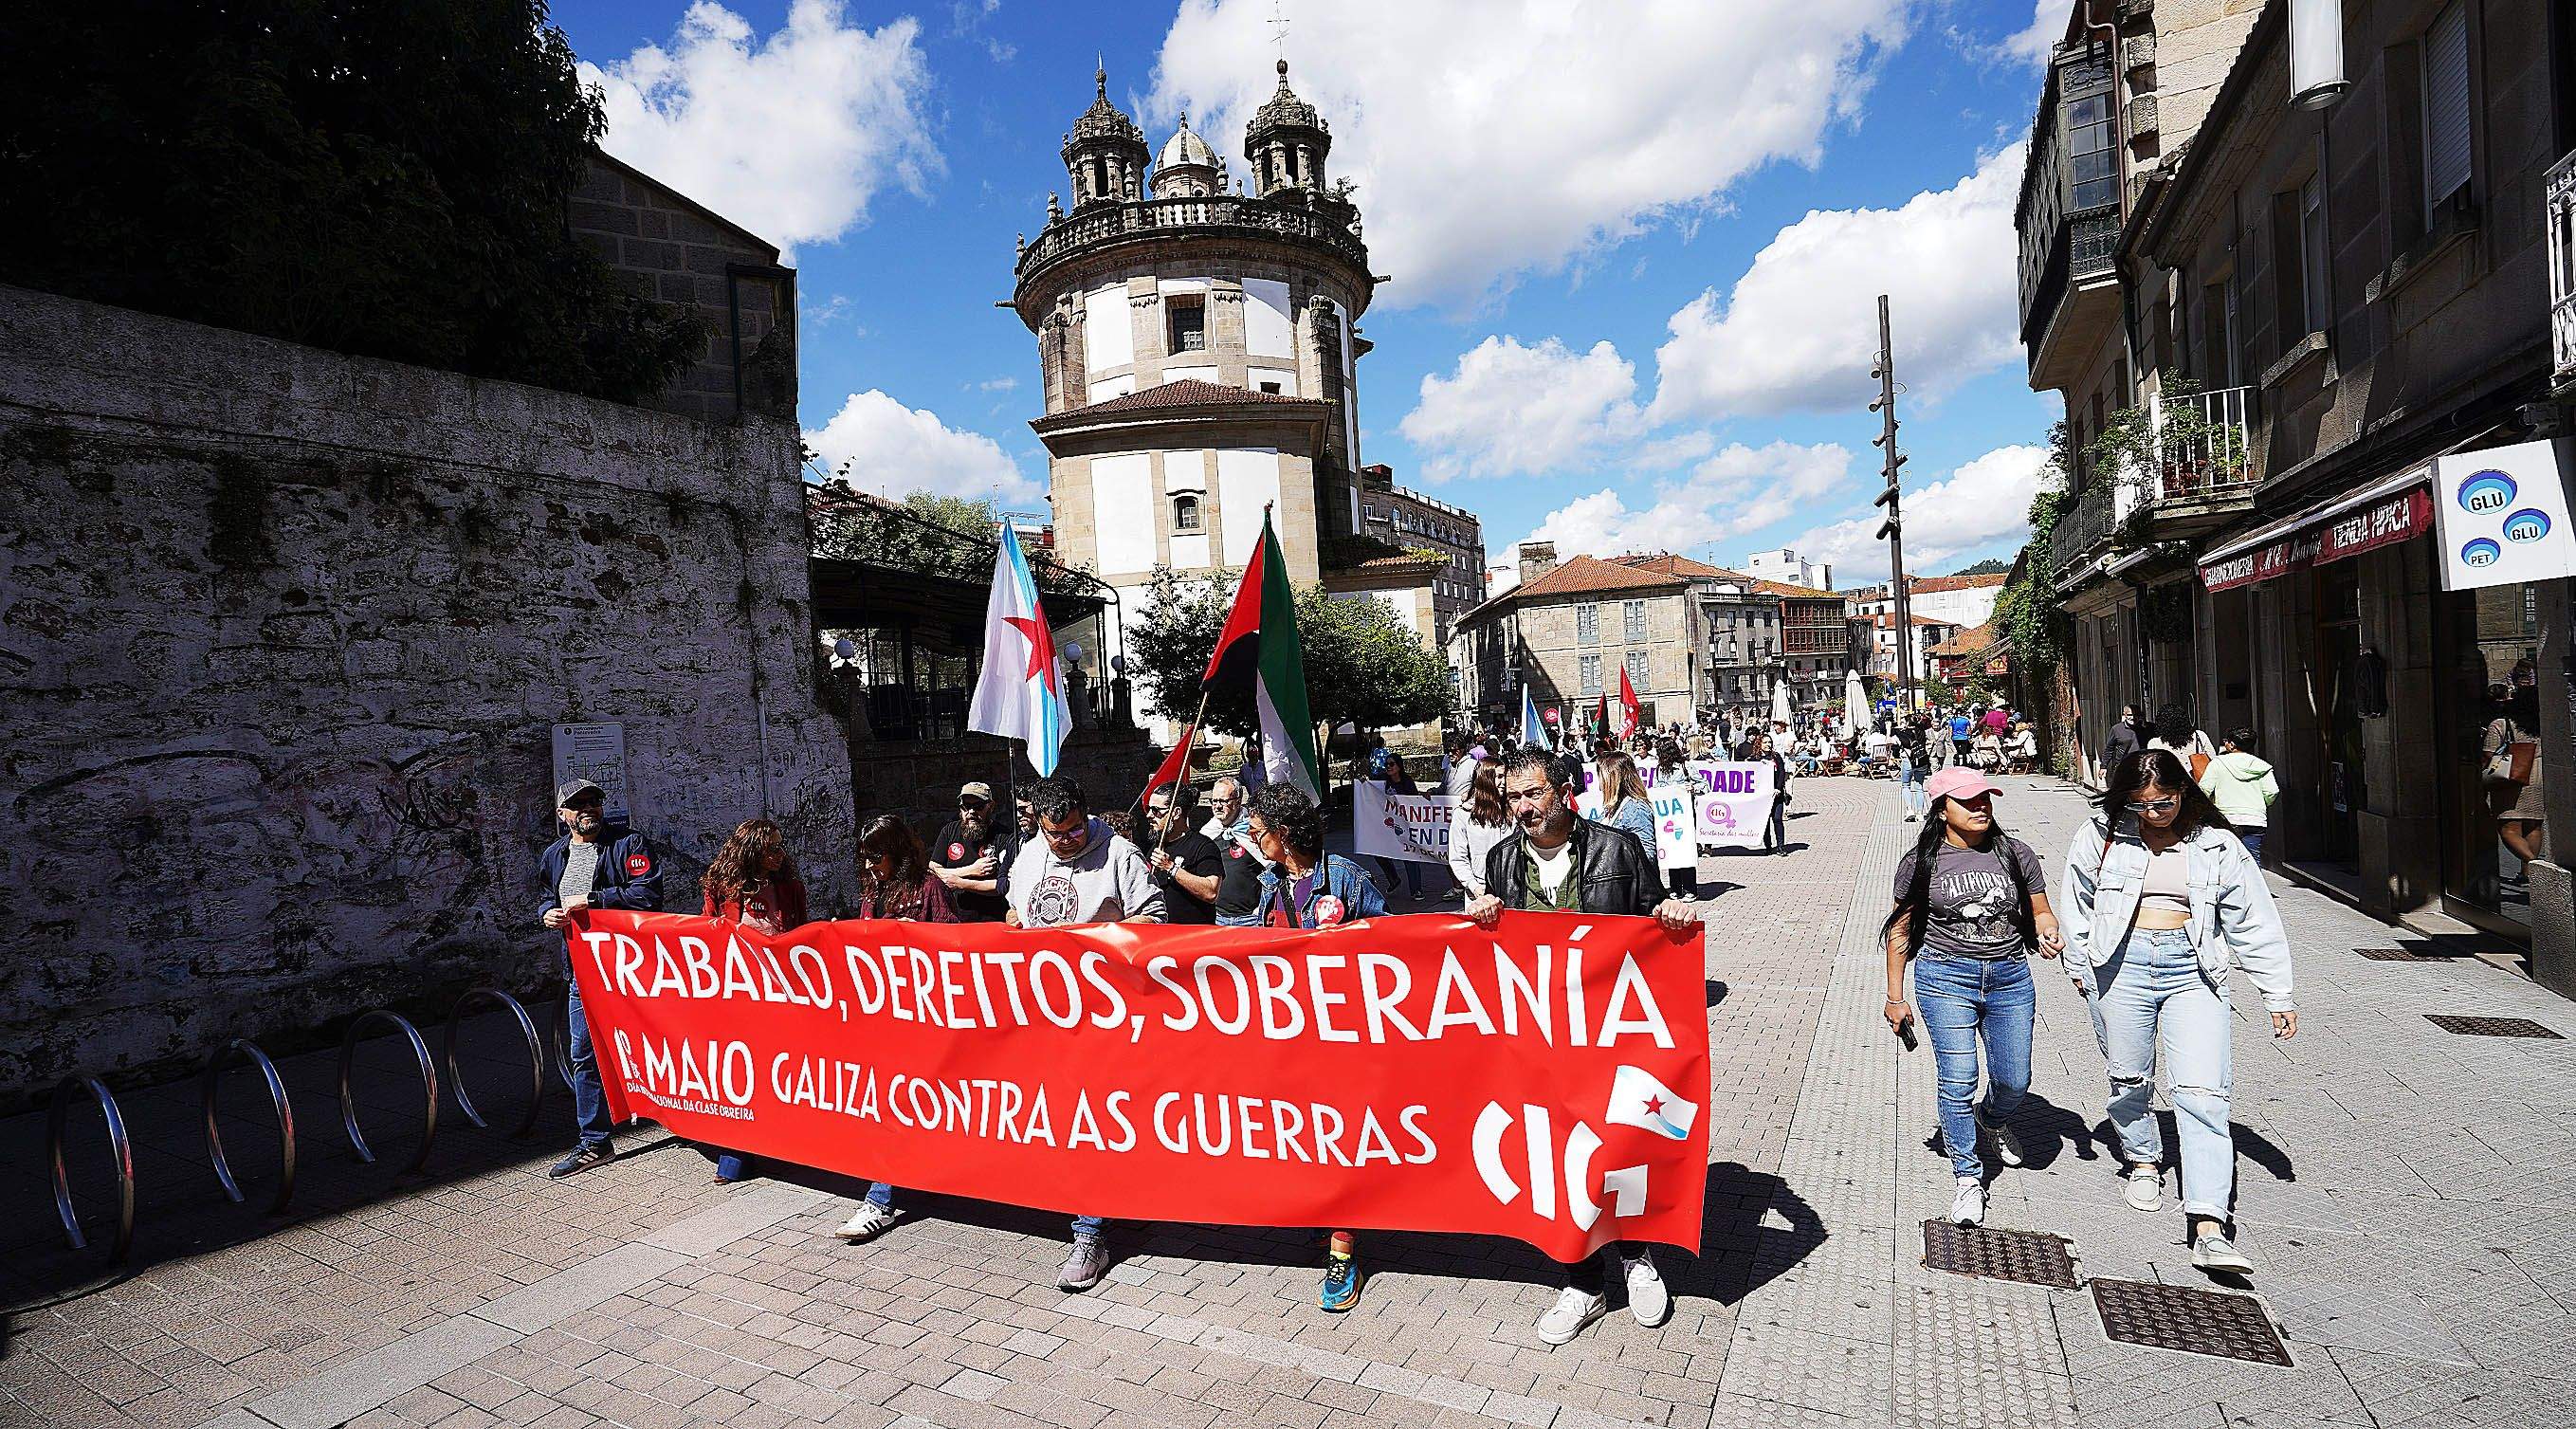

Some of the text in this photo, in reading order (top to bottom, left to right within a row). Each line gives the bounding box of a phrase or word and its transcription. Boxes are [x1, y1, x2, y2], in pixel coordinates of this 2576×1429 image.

[2471, 491, 2504, 512] GLU
[2512, 524, 2539, 541] GLU
[2471, 554, 2491, 565] PET
[1409, 828, 1433, 845] EN
[581, 925, 1675, 1049] TRABALLO, DEREITOS, SOBERANÍA
[641, 1032, 755, 1106] MAIO
[683, 1099, 695, 1112] DA
[695, 1100, 720, 1115] CLASE
[719, 1105, 756, 1122] OBREIRA
[772, 1052, 1437, 1167] GALIZA CONTRA AS GUERRAS
[1471, 1100, 1649, 1232] CIG
